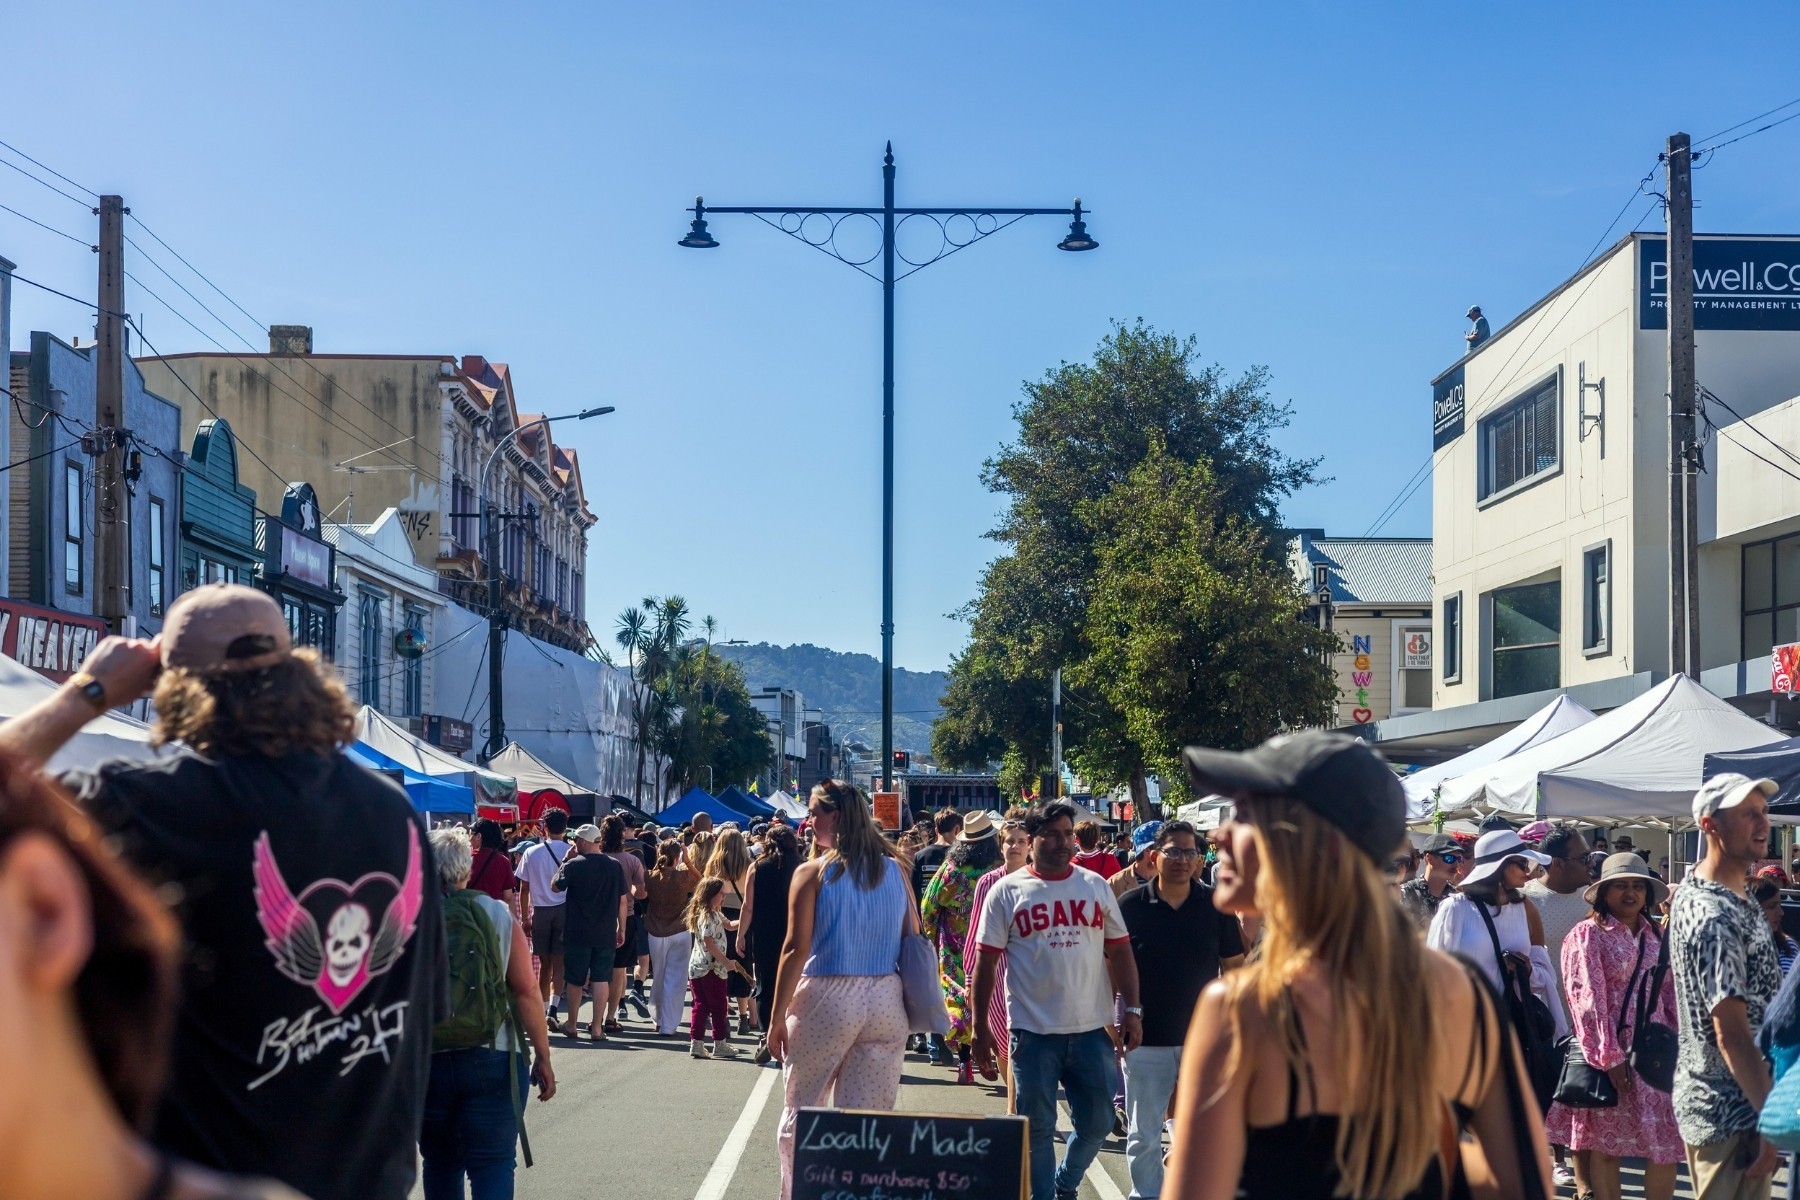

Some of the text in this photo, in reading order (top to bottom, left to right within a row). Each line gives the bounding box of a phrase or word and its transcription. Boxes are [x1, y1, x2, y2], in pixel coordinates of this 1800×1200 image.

[1711, 301, 1787, 310] MANAGEMENT
[1015, 899, 1105, 938] OSAKA
[1047, 930, 1081, 938] JAPAN
[1049, 939, 1080, 949] サッカー
[801, 1115, 991, 1161] Locally Made
